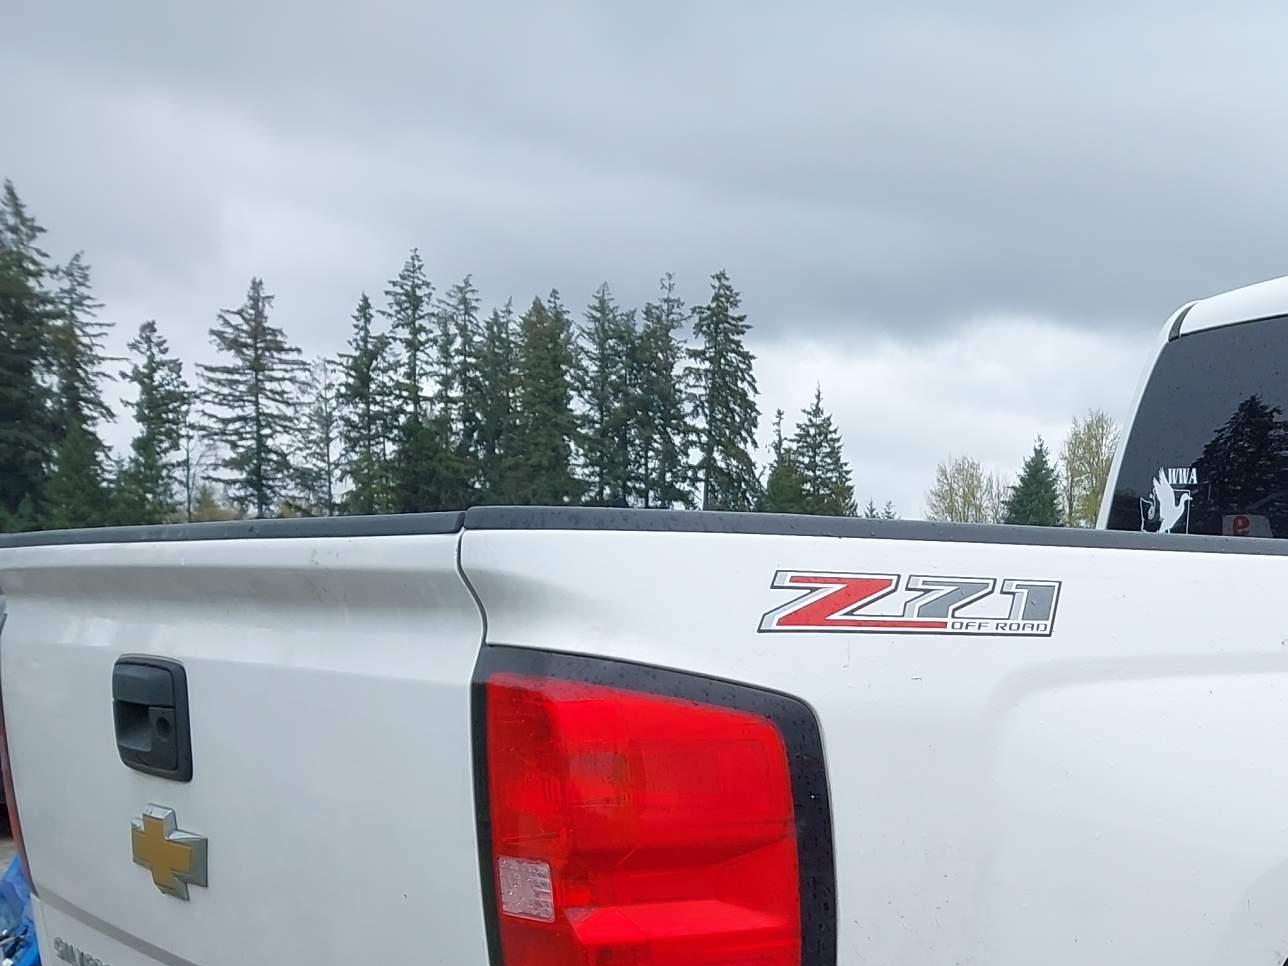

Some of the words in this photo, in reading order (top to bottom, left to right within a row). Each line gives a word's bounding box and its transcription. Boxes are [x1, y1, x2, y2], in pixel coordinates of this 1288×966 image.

[757, 570, 1062, 637] Z71
[951, 621, 991, 631] OFF
[995, 621, 1048, 632] ROAD
